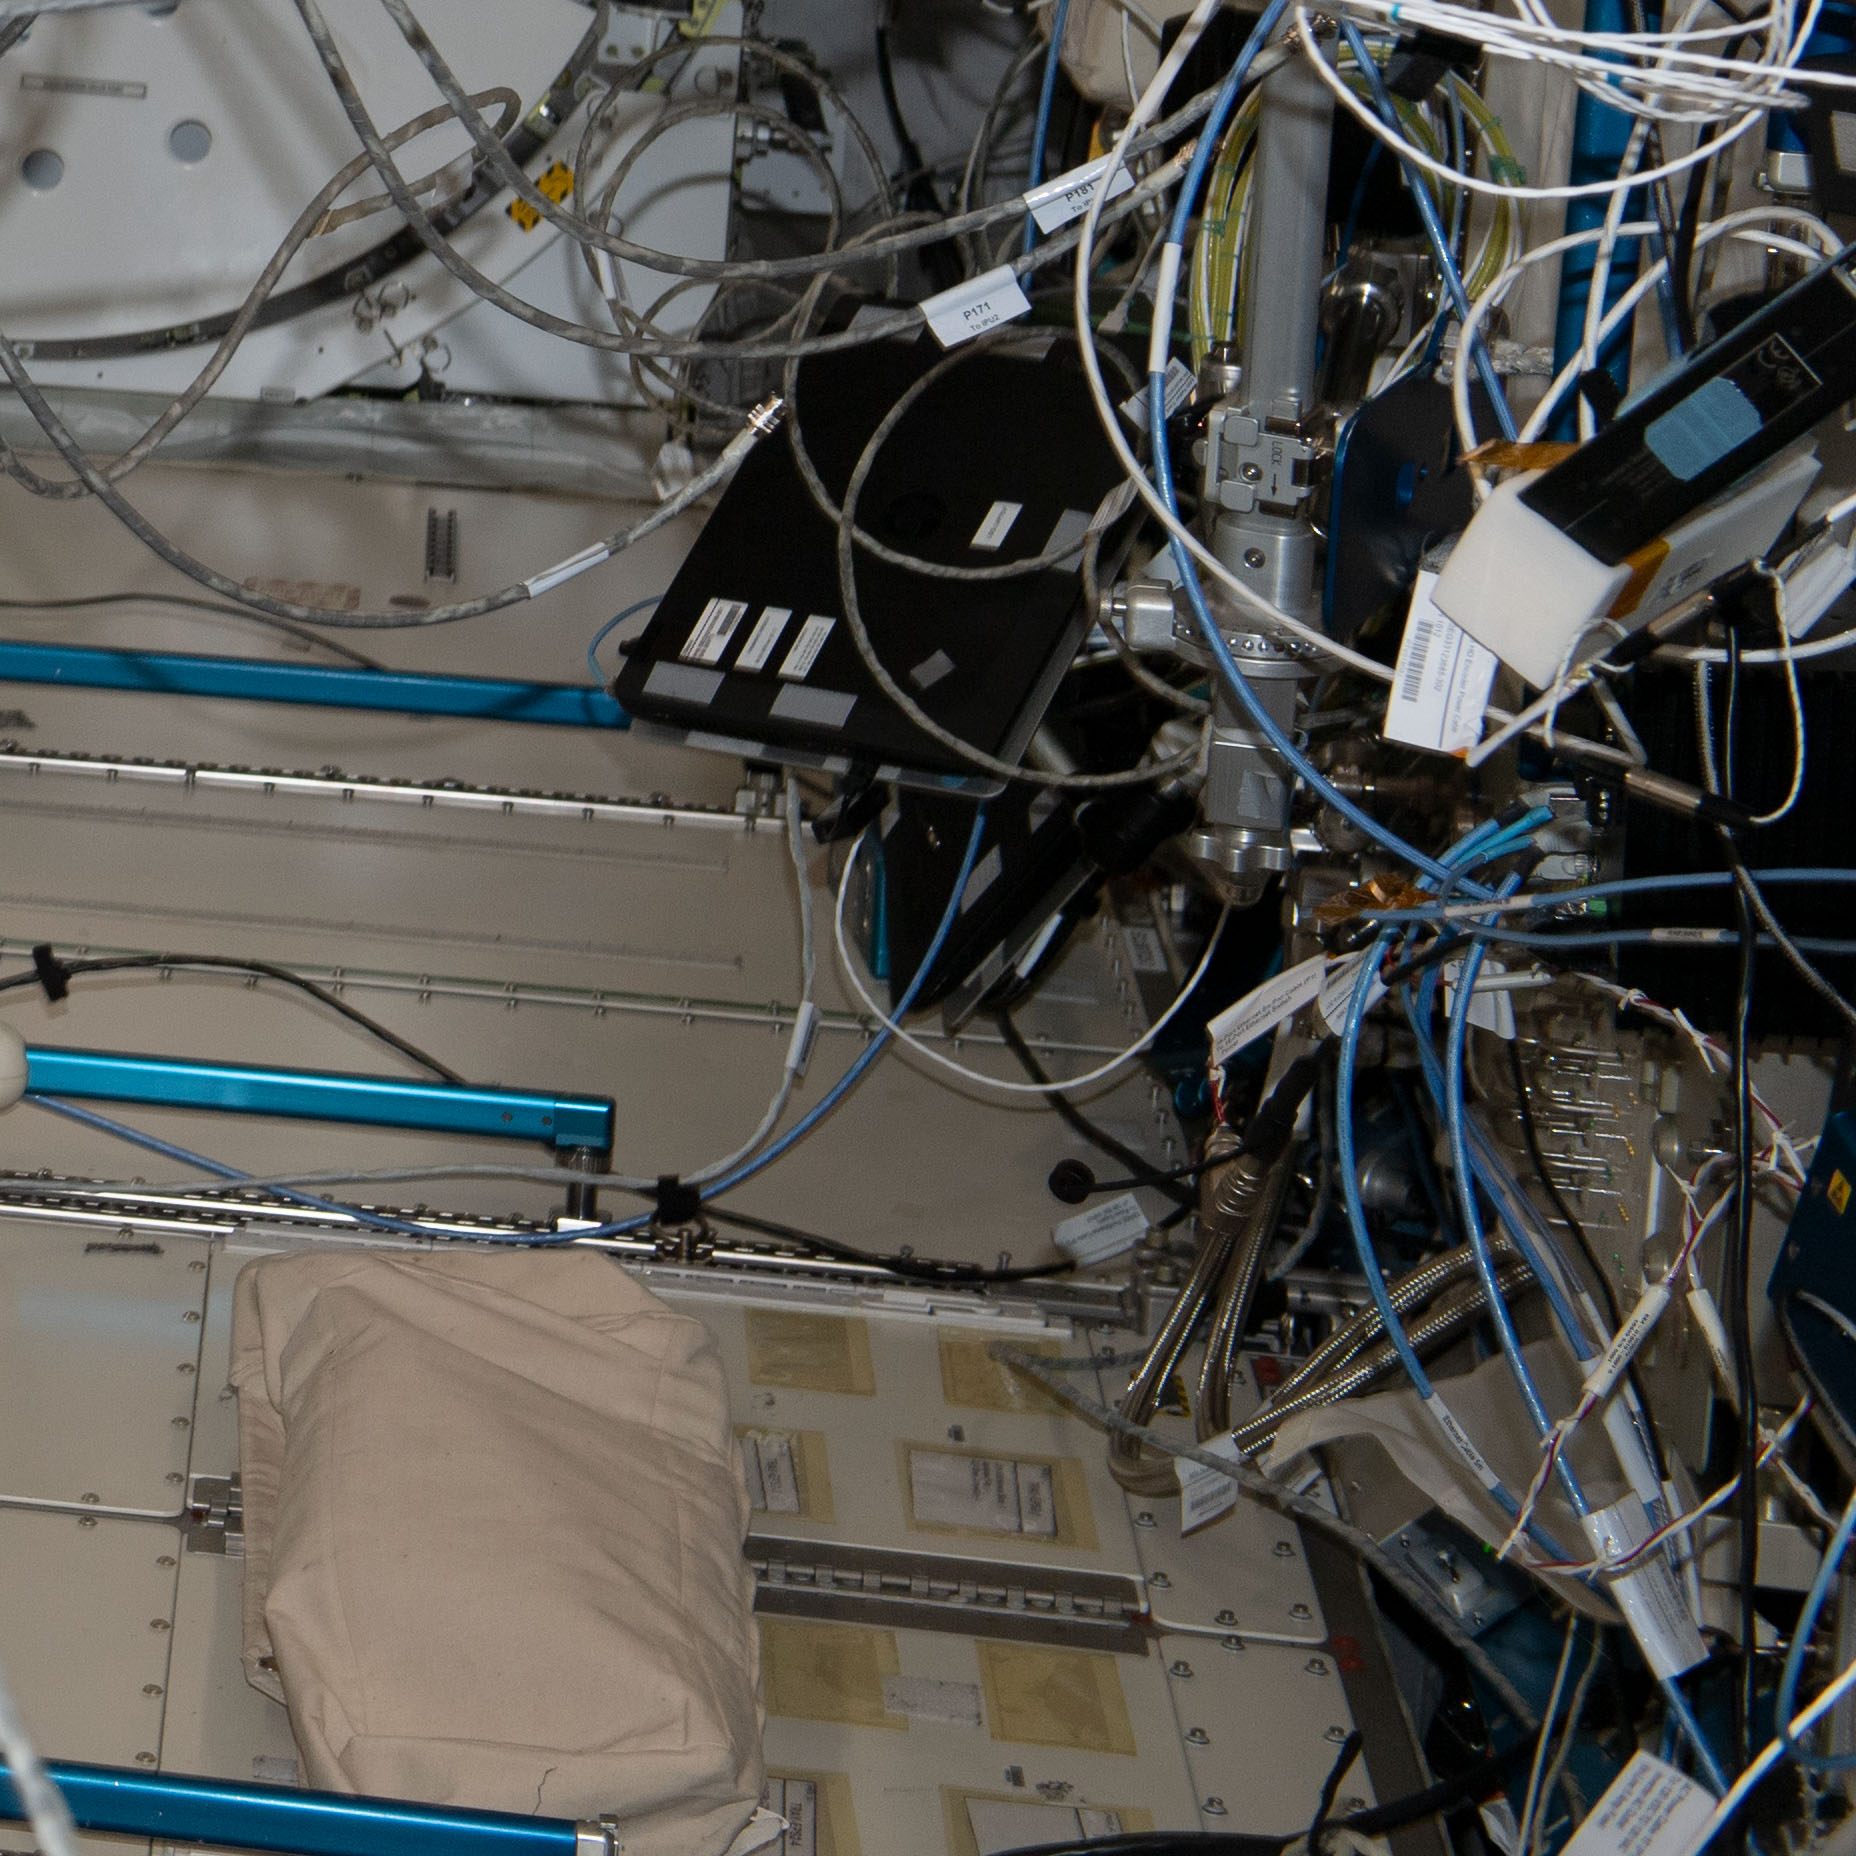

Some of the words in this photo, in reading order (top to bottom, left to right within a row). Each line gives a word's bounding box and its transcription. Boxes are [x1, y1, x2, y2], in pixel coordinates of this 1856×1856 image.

[1063, 181, 1096, 202] P181
[961, 300, 993, 322] P171
[969, 321, 982, 332] To
[980, 312, 1001, 327] IPU2
[1270, 440, 1283, 466] LOCK
[1452, 690, 1466, 715] Power
